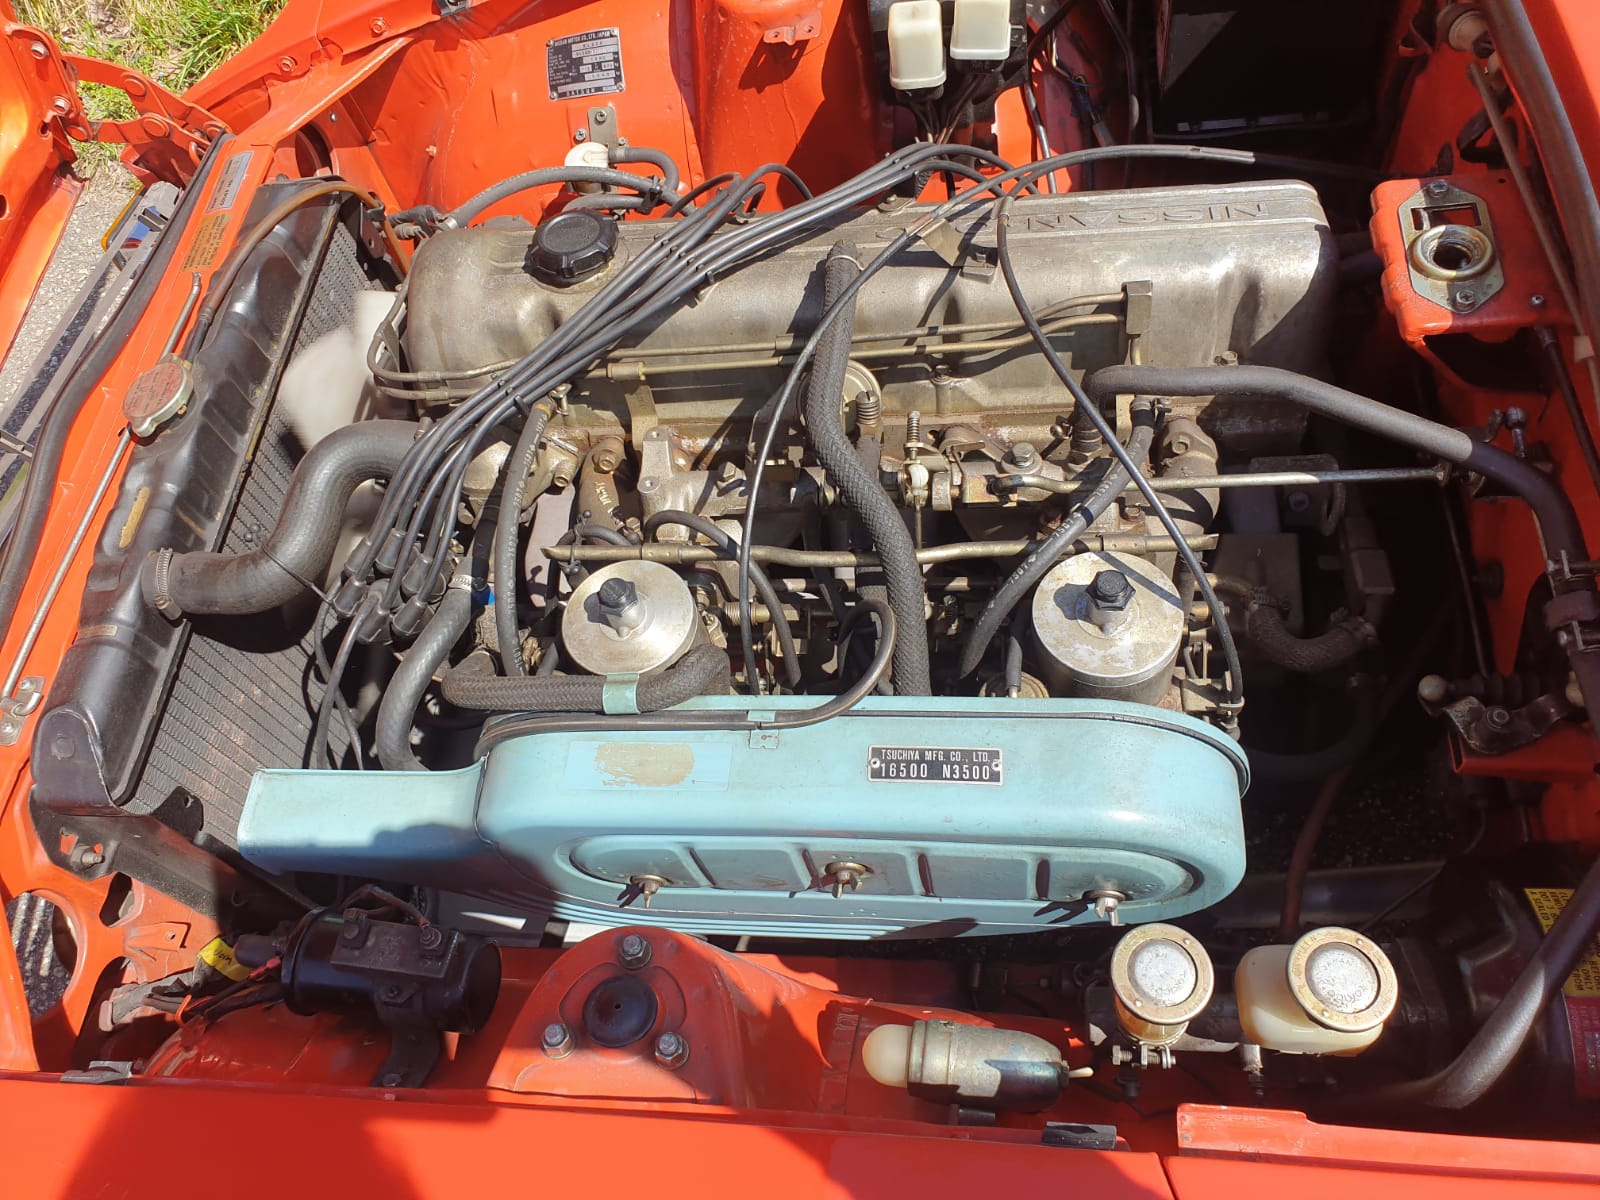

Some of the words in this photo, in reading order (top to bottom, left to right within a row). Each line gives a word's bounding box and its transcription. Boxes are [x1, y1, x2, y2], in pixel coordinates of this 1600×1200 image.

[1025, 200, 1270, 231] NISSAN
[1053, 519, 1075, 538] 7507
[881, 749, 920, 760] TSUCHIYA
[925, 750, 946, 761] MFG.
[950, 751, 969, 763] CO.,
[972, 752, 991, 763] LTD.
[880, 762, 928, 778] 16500
[942, 764, 990, 780] N3500
[1533, 898, 1550, 921] SEALED
